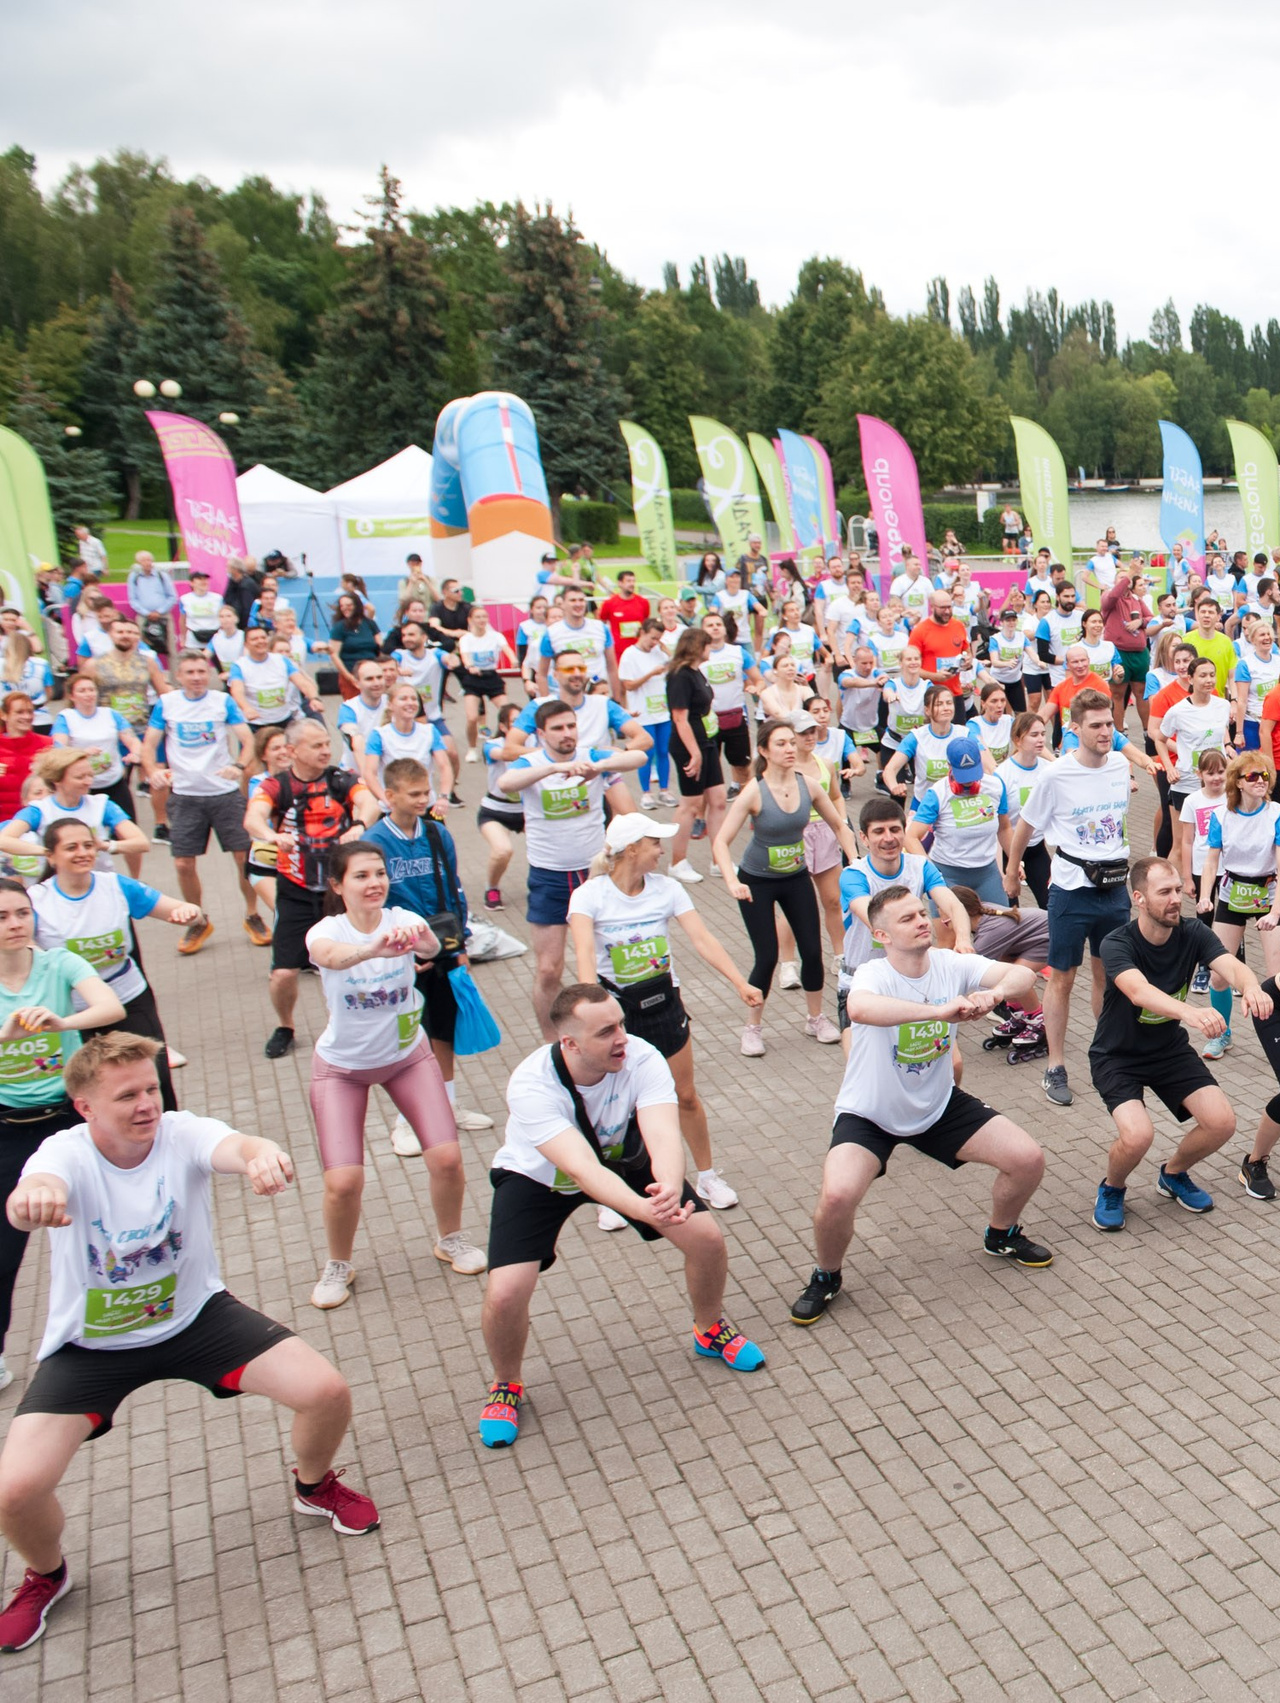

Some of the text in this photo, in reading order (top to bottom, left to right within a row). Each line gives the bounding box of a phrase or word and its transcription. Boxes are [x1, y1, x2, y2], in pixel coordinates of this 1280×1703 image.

[549, 788, 580, 802] 1148
[958, 796, 984, 809] 1165
[775, 847, 803, 859] 1094
[1236, 884, 1261, 898] 1014
[77, 934, 117, 953] 1433
[621, 942, 658, 961] 1431
[909, 1020, 944, 1040] 1430
[0, 1037, 49, 1058] 1405
[102, 1285, 163, 1309] 1429
